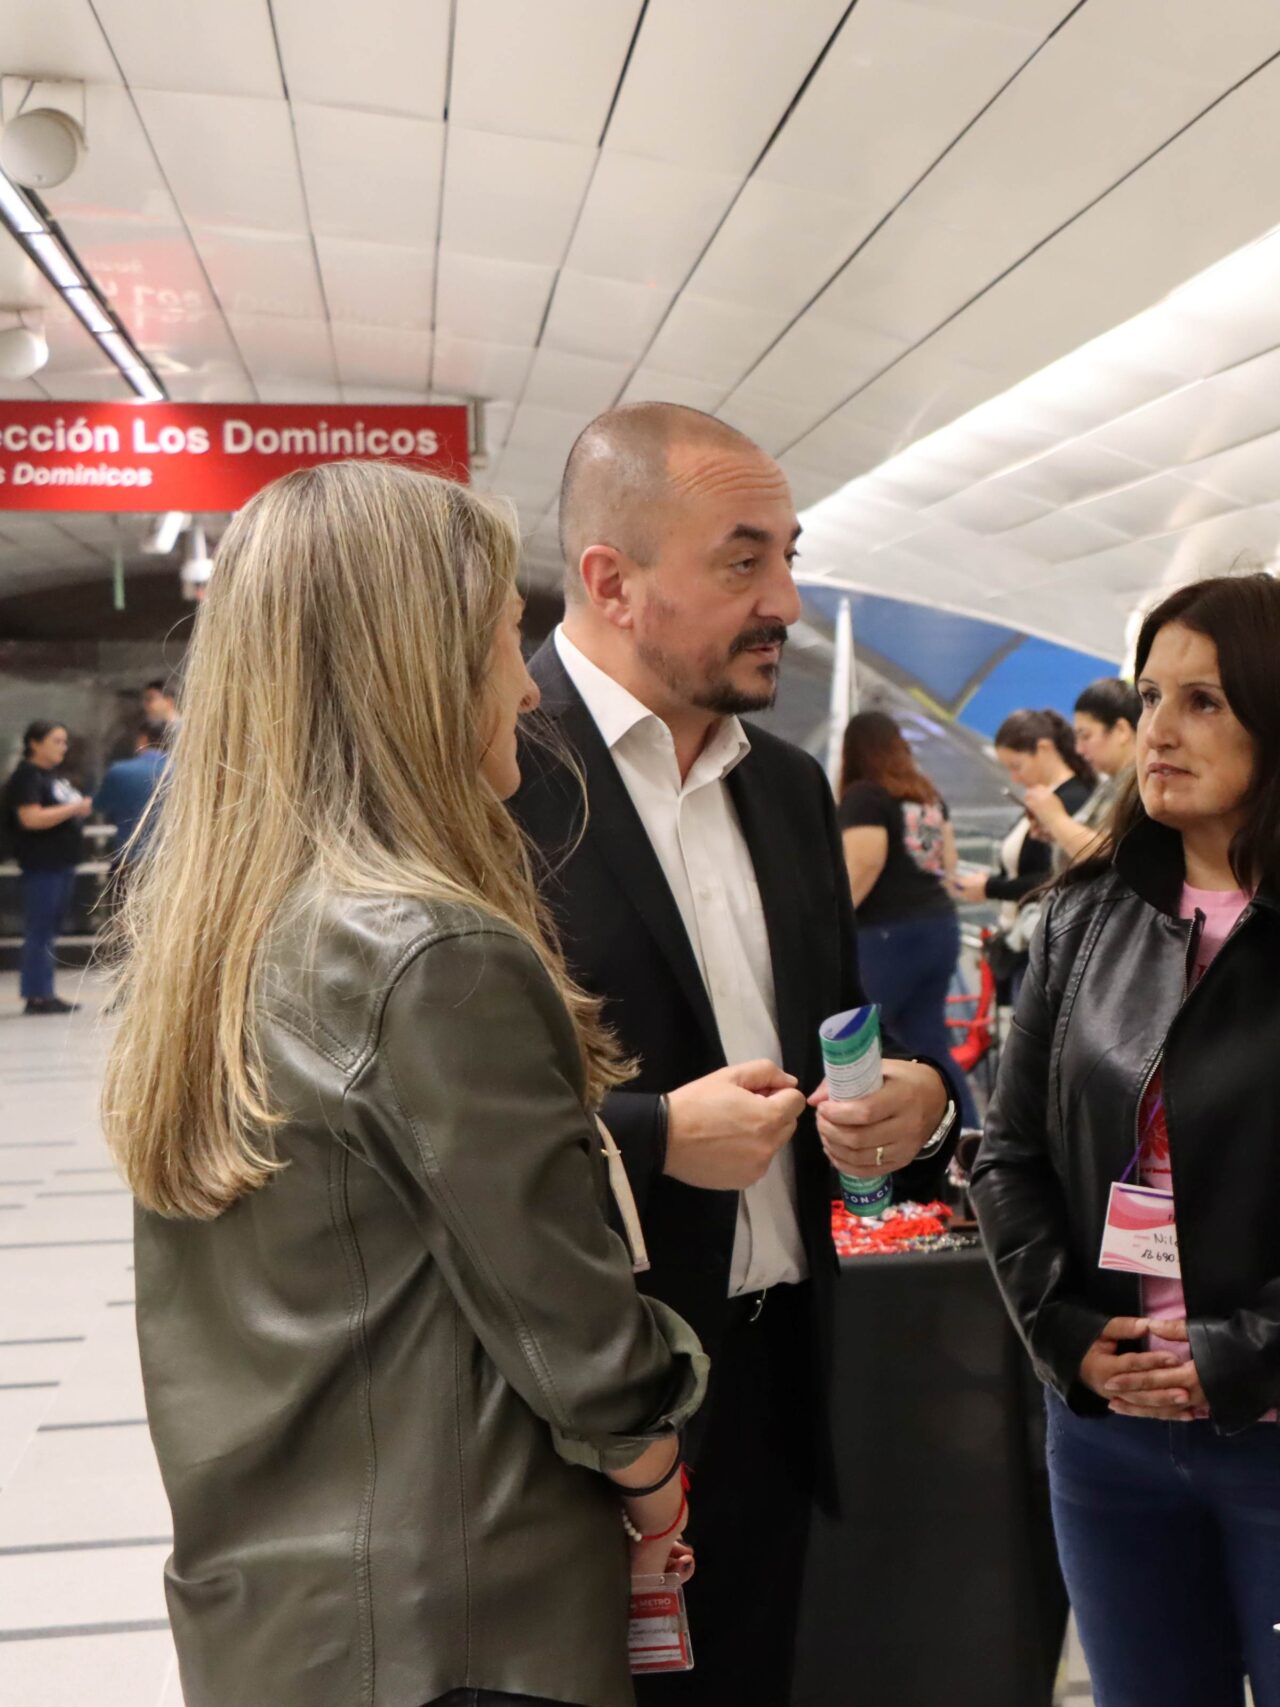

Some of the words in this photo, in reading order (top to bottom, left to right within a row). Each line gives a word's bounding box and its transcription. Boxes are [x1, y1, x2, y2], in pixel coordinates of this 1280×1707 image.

[0, 417, 120, 453] cción
[133, 418, 210, 453] Los
[223, 420, 438, 455] Dominicos
[12, 462, 152, 487] Dominicos
